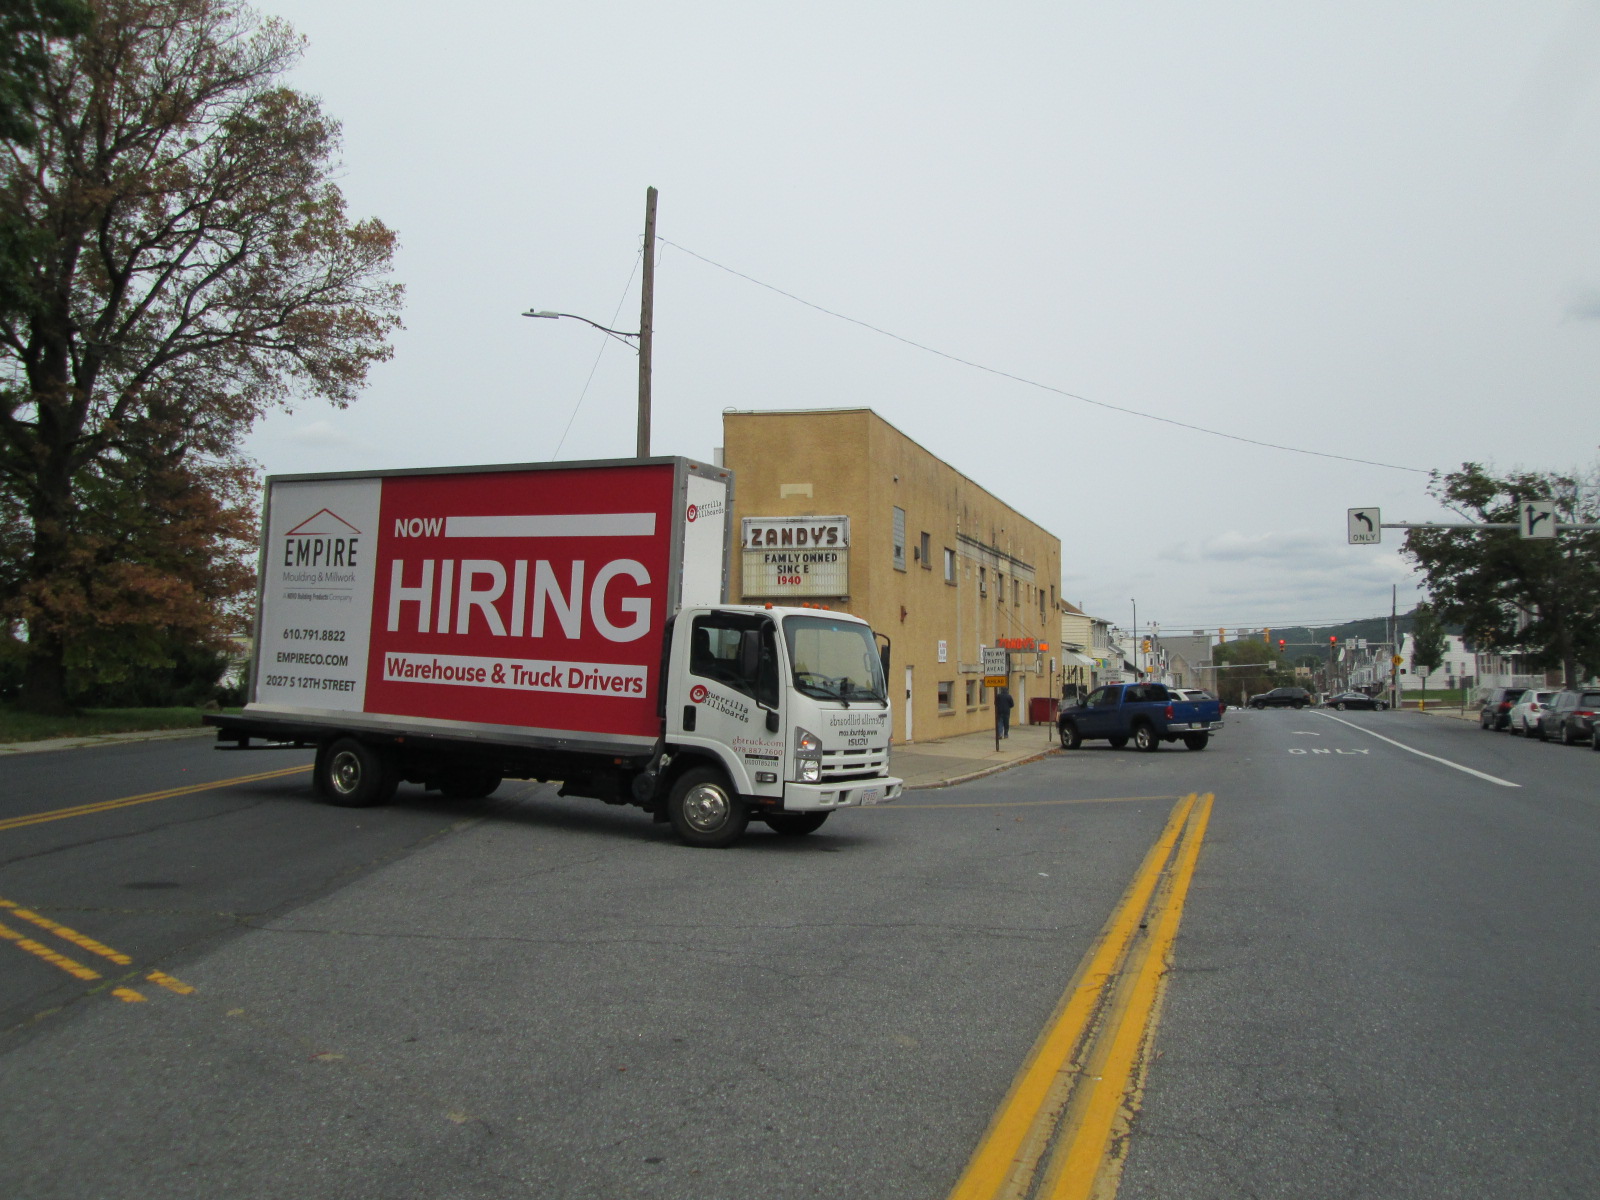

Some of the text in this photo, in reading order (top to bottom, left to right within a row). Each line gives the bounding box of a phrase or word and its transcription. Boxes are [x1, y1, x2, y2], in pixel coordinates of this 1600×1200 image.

[394, 517, 444, 538] NOW
[751, 525, 838, 546] ZANDY'S
[1353, 534, 1377, 542] ONLY
[284, 538, 360, 567] EMPIRE
[802, 553, 838, 564] OWNED
[777, 564, 810, 574] SINCE
[282, 571, 356, 585] Moulding & Millwork
[777, 575, 802, 585] 1940
[329, 594, 353, 604] Company
[387, 558, 653, 643] HIRING
[283, 628, 346, 642] 610.791.8822
[276, 652, 349, 667] EMPIRECO.COM
[387, 657, 643, 695] Warehouse & Truck Drivers
[266, 674, 357, 693] 2027 S 12TH STREET
[705, 690, 749, 714] guerrilla
[702, 696, 750, 723] billboards
[732, 736, 784, 748] gbtruck.com
[847, 738, 869, 746] ISUZU
